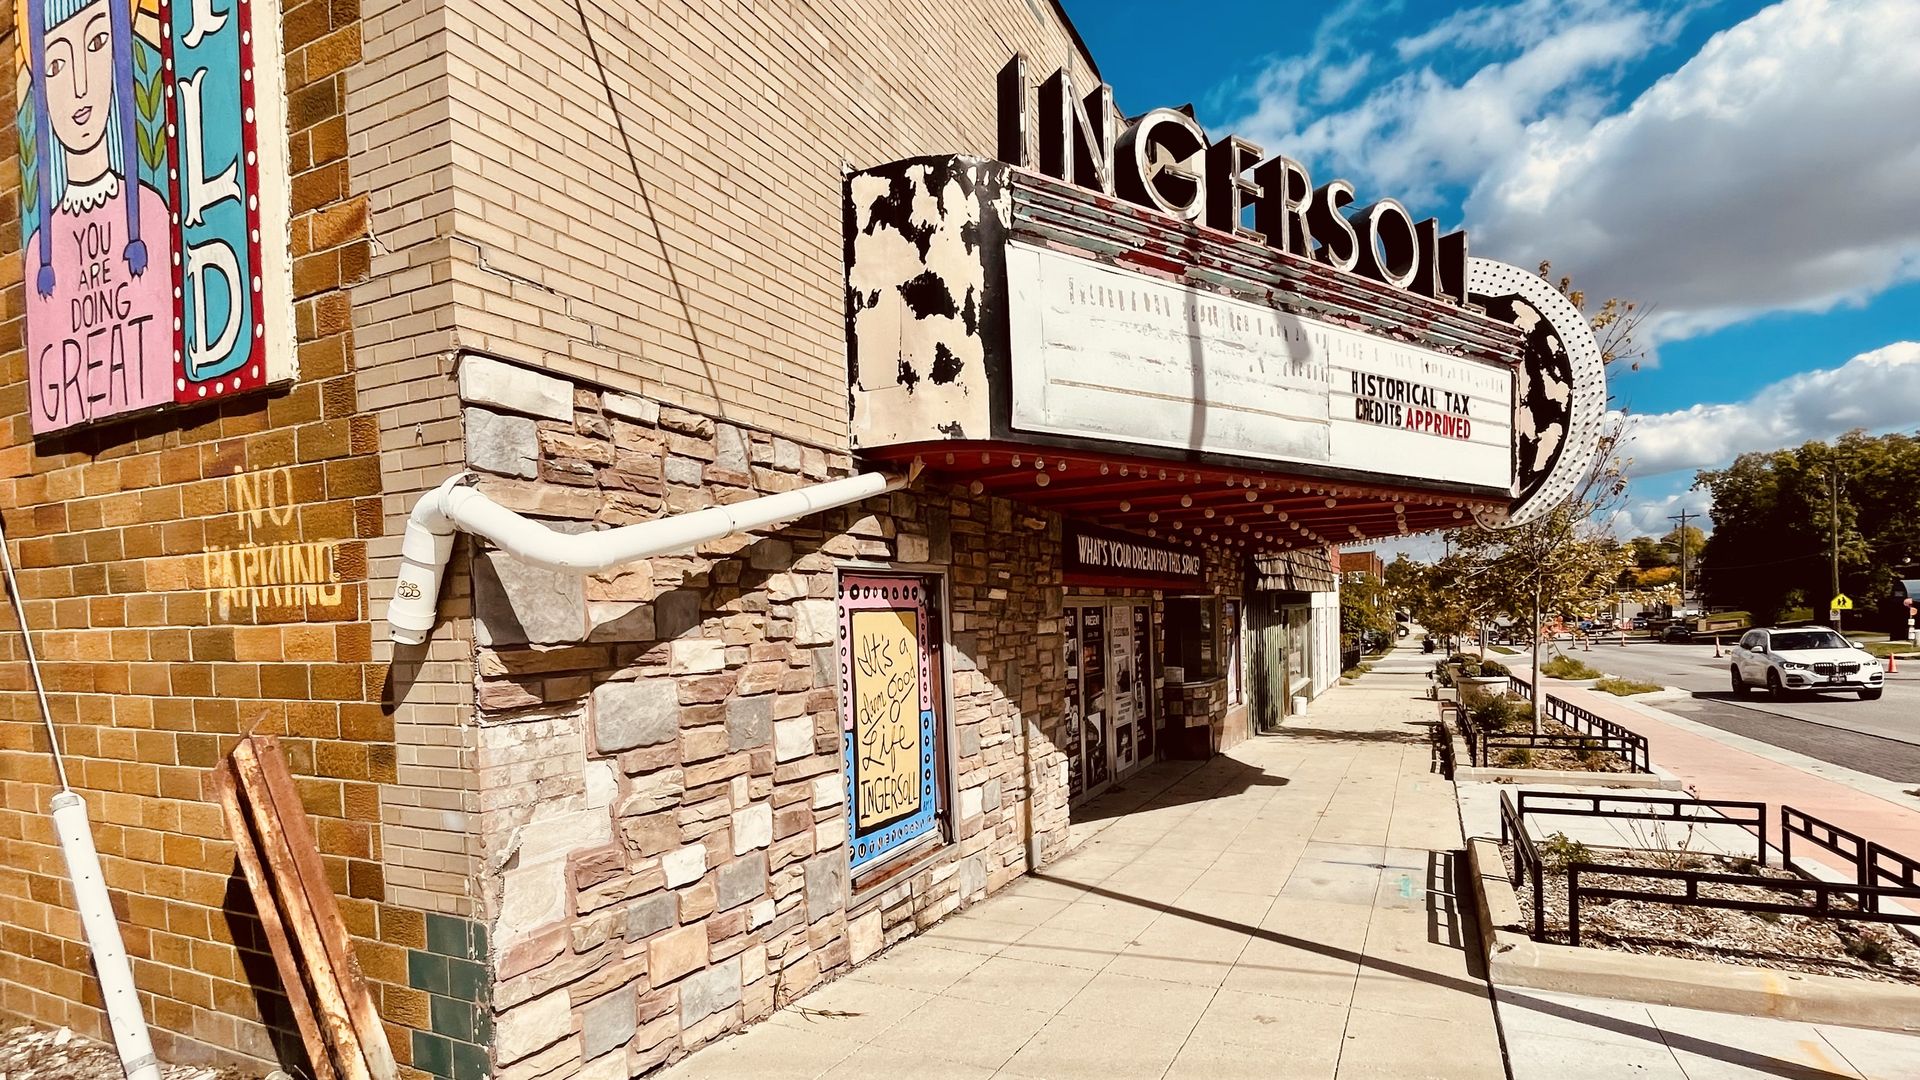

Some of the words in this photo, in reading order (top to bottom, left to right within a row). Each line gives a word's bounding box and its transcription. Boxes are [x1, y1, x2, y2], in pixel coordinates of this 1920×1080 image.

[997, 52, 1486, 315] INGERSOLL
[73, 222, 112, 256] YOU
[79, 257, 112, 286] ARE
[71, 282, 131, 333] DOING
[39, 314, 154, 424] GREAT
[1351, 371, 1437, 409] HISTORICAL
[1445, 391, 1470, 416] TAX
[1355, 397, 1402, 427] CREDITS
[1406, 407, 1471, 440] APPROVED
[234, 463, 294, 530] NO
[202, 540, 342, 608] PARKING
[1077, 534, 1108, 566] WHAT'S
[1109, 540, 1132, 569] YOUR
[1132, 544, 1156, 571] DREAM
[1157, 549, 1168, 572] FOR
[1168, 551, 1181, 574] THIS
[857, 633, 894, 677] It's
[861, 724, 915, 773] Life
[860, 771, 918, 820] INGERSOLL
